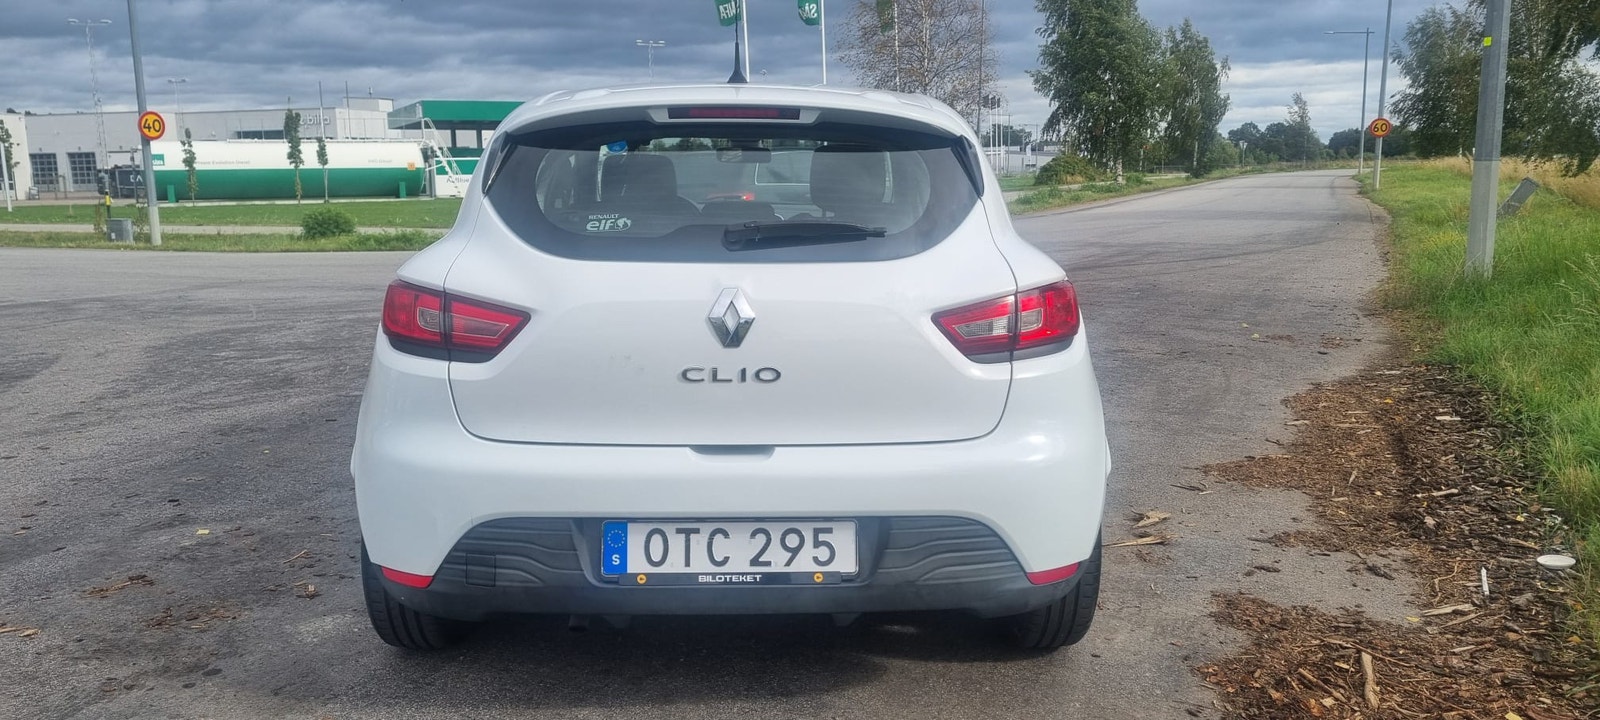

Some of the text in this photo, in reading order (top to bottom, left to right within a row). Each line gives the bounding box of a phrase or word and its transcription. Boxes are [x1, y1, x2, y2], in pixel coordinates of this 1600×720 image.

[143, 118, 161, 133] 40
[1374, 123, 1388, 132] 60
[586, 219, 615, 231] elf
[681, 366, 782, 383] CLIO
[644, 527, 836, 567] OTC 295
[611, 554, 620, 565] S
[698, 574, 762, 583] BILOTEKET
